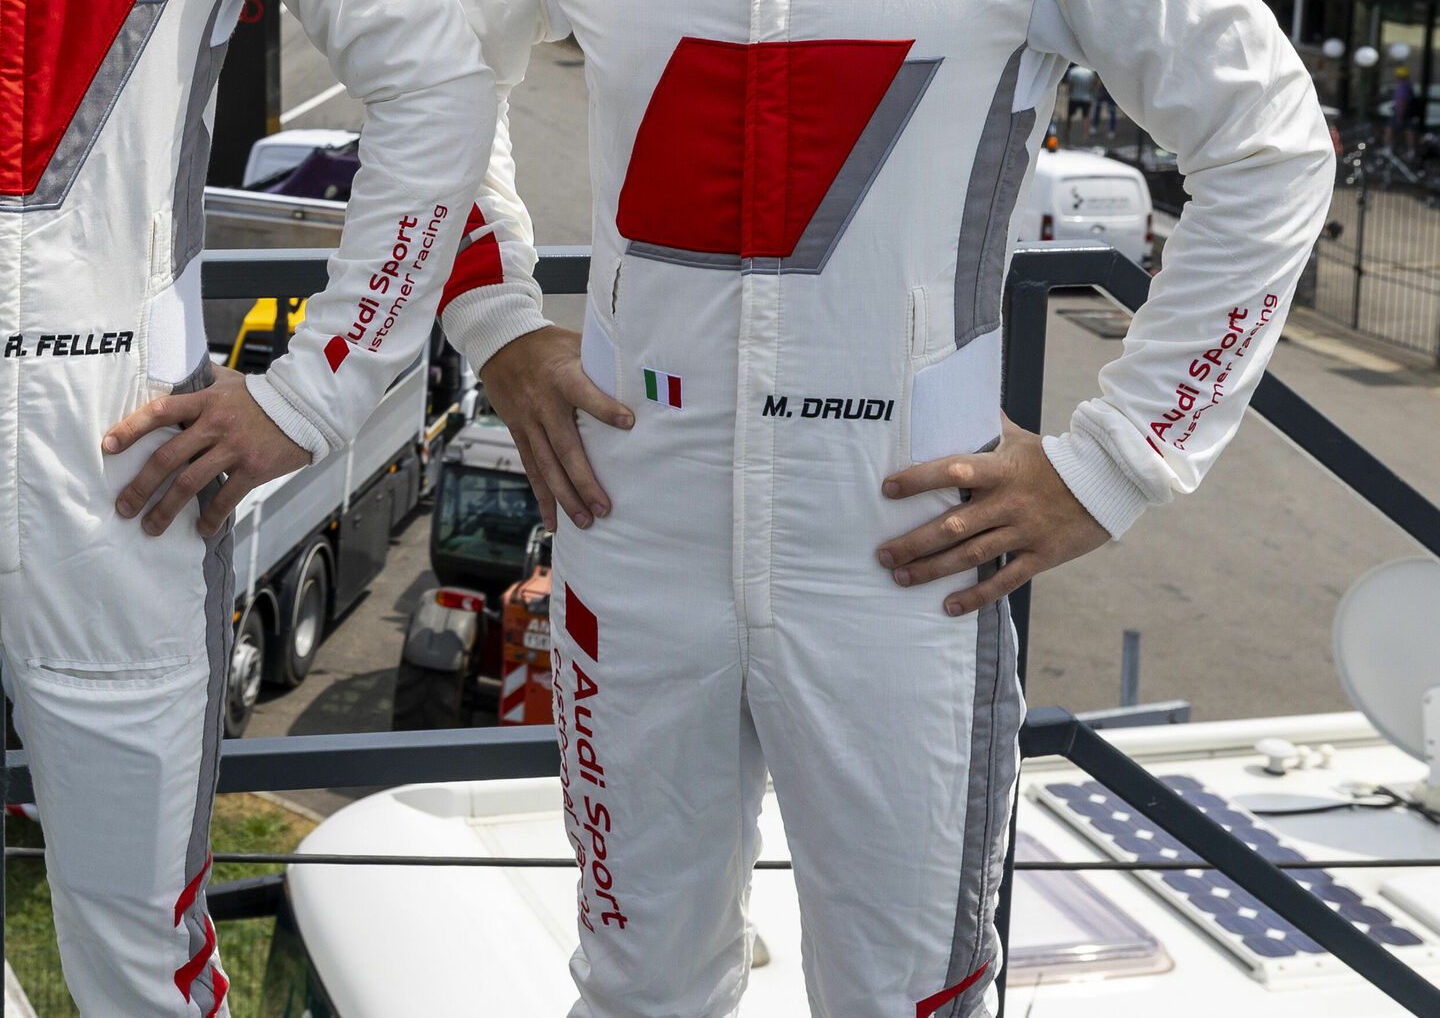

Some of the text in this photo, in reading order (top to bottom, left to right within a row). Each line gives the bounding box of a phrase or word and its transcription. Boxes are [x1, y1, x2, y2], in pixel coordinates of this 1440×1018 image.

[346, 215, 418, 345] udi Sport
[368, 204, 448, 353] stomer racing
[1235, 293, 1278, 357] racing
[36, 331, 134, 357] FELLER
[762, 395, 895, 421] M. DRUDI
[1150, 306, 1248, 442] Audi Sport
[571, 659, 628, 930] Audi Sport
